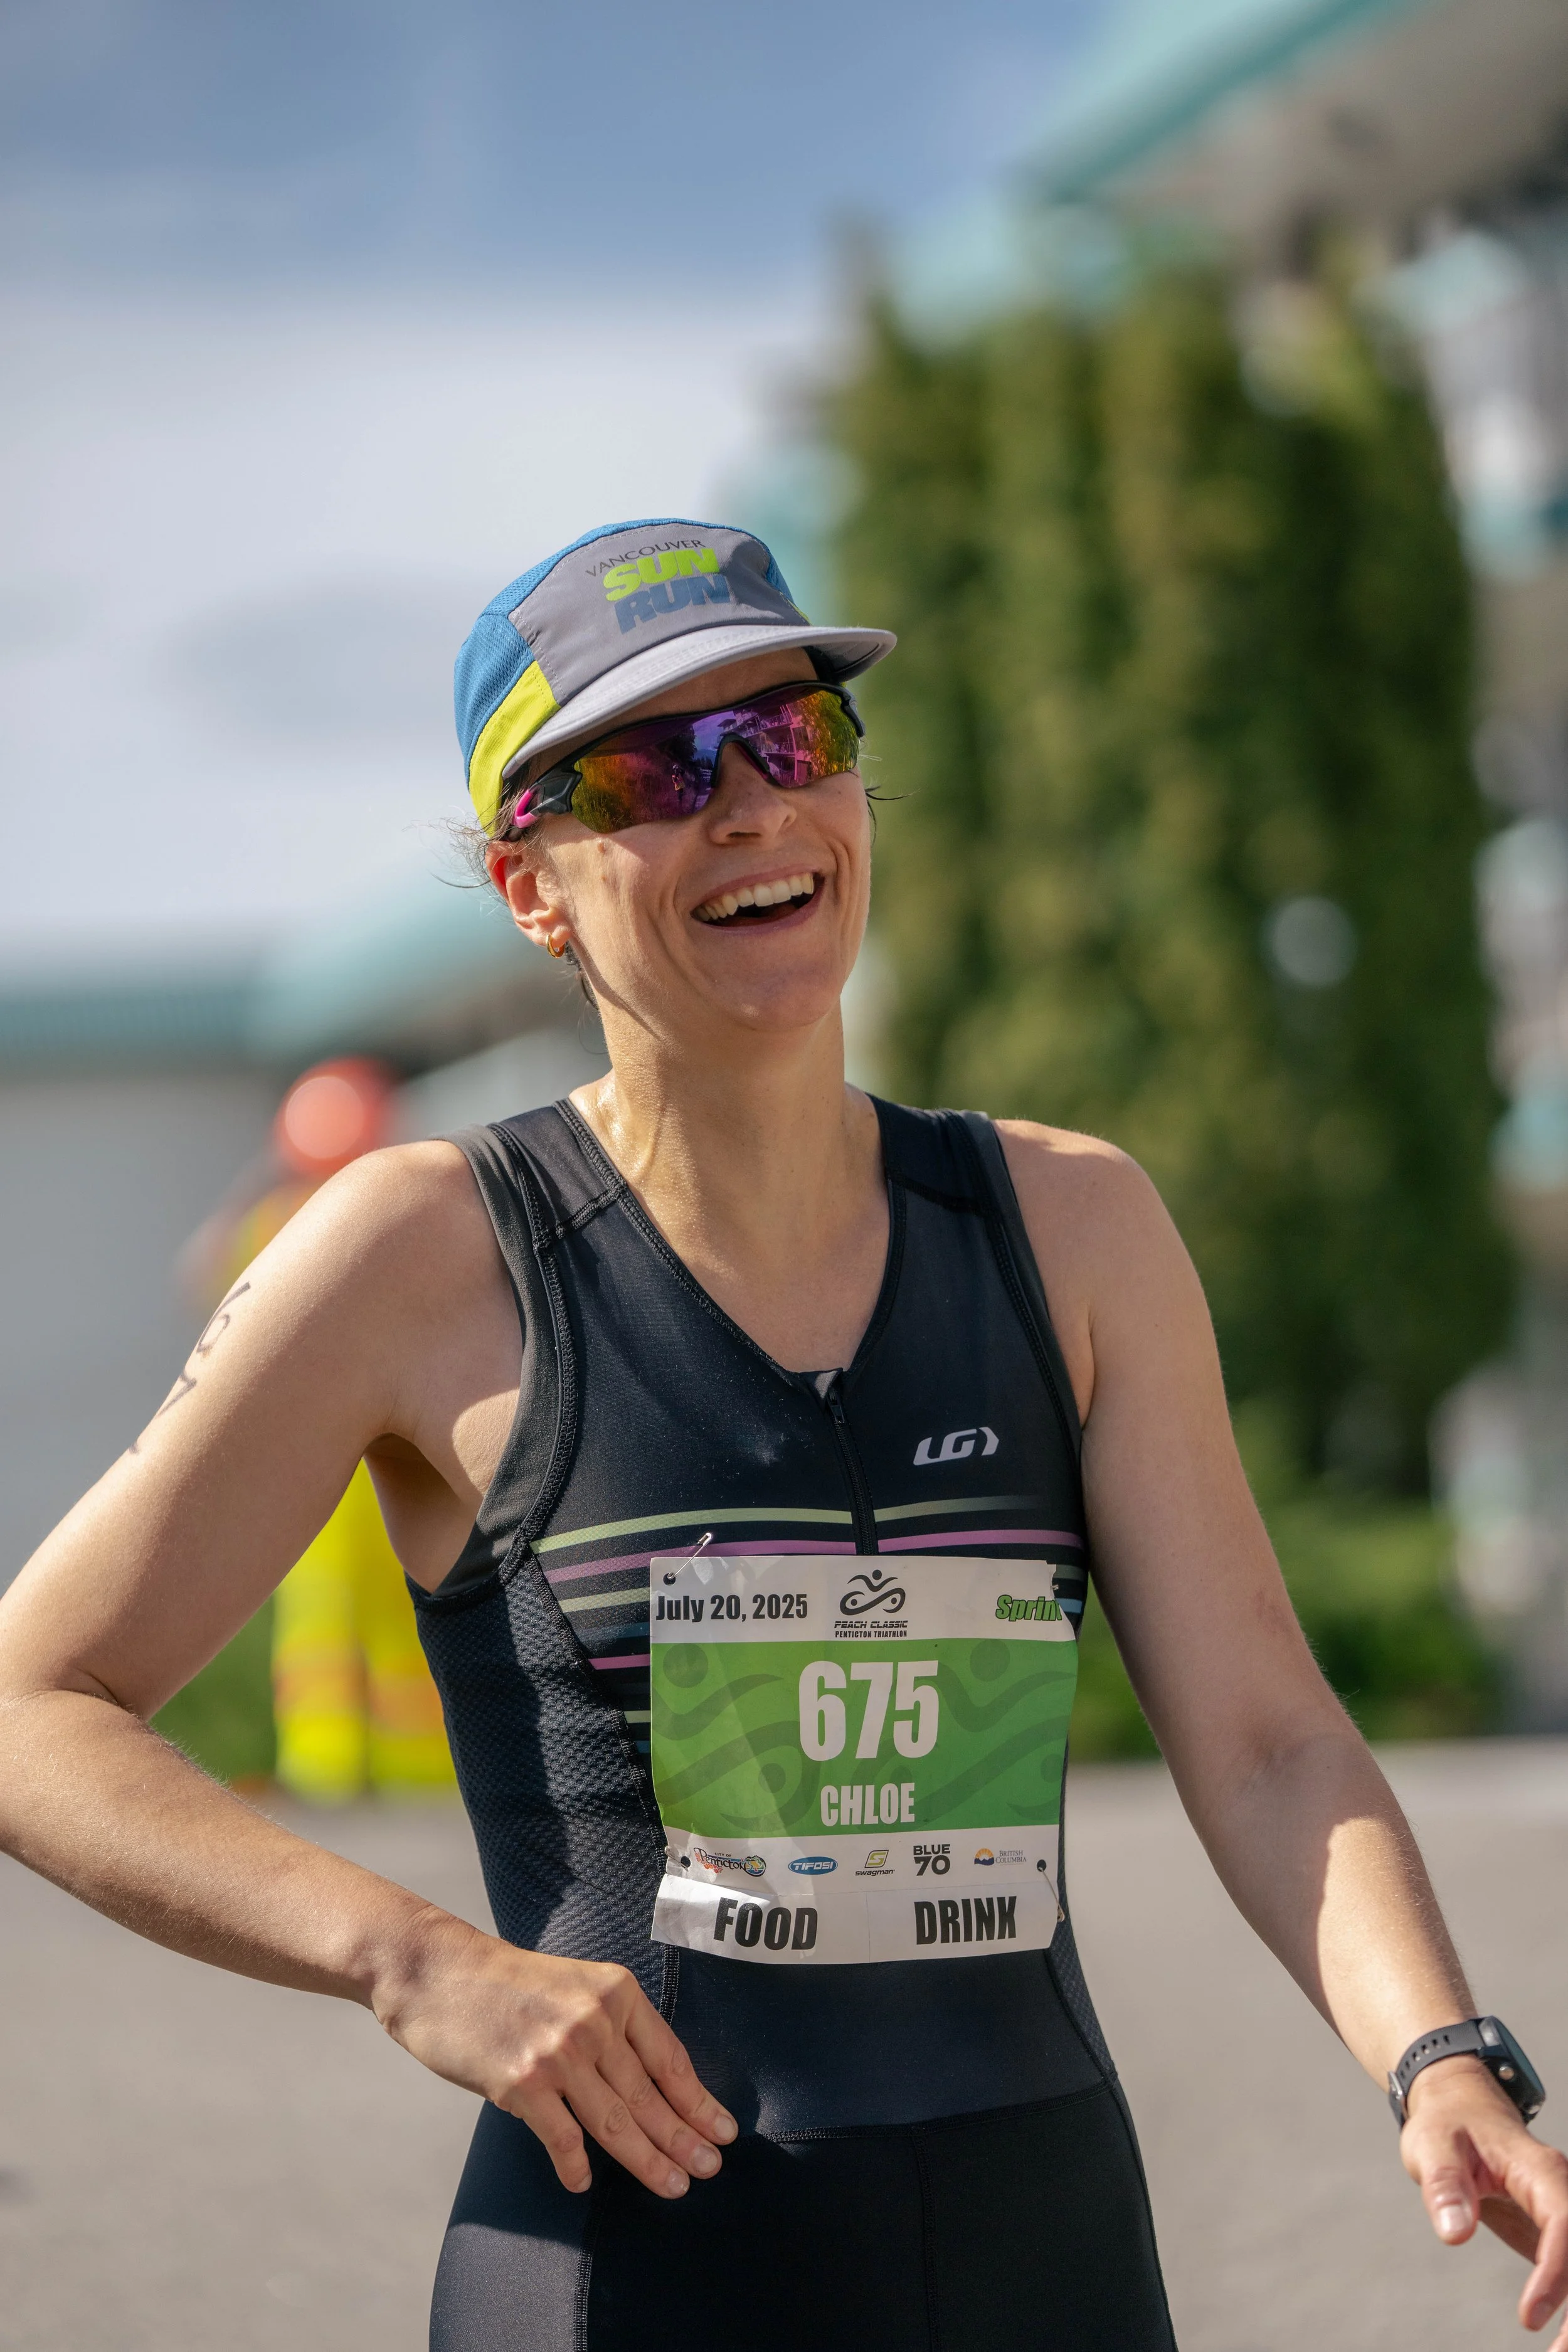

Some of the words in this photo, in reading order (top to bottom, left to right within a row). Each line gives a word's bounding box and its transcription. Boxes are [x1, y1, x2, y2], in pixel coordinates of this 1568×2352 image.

[586, 539, 706, 577] VANCOUVER
[603, 548, 719, 602] SUN
[613, 573, 731, 634] RUN
[656, 1595, 704, 1623] July
[711, 1594, 746, 1622] 20,
[753, 1593, 807, 1619] 2025
[834, 1621, 867, 1629] PEACH
[870, 1620, 908, 1629] CLASSIC
[874, 1630, 907, 1638] TRIATHLON
[798, 1660, 939, 1761] 675
[820, 1783, 915, 1826] CHLOE
[913, 1844, 950, 1855] BLUE
[995, 1856, 1027, 1864] COLUMBIA
[793, 1862, 834, 1870] TIFOSI
[914, 1855, 950, 1876] 70
[713, 1897, 818, 1951] FOOD
[914, 1895, 1017, 1945] DRINK
